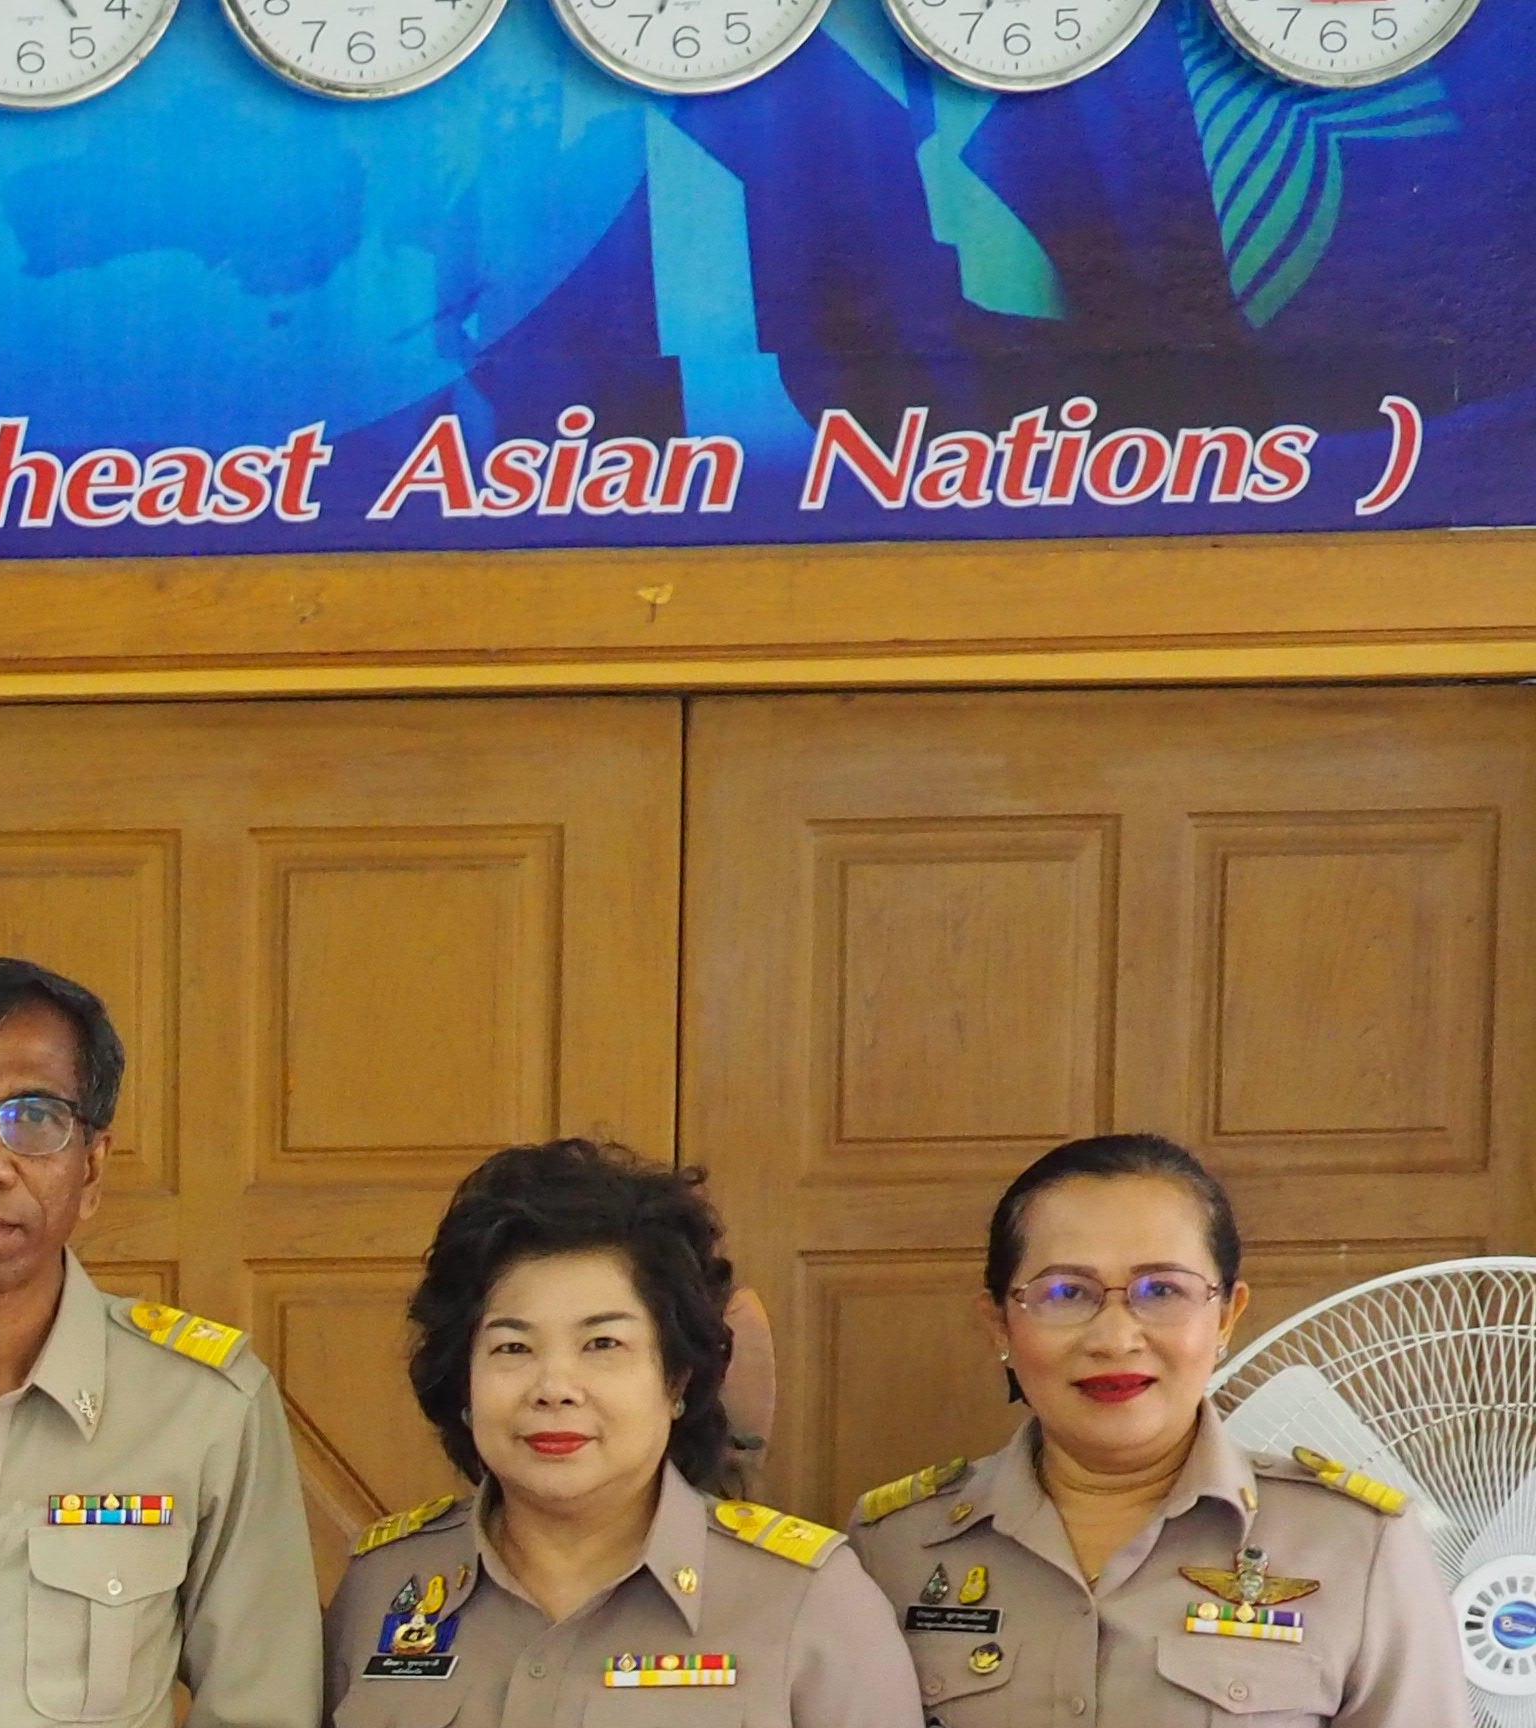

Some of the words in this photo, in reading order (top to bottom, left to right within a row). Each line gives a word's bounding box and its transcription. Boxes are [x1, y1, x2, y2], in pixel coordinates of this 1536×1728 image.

[301, 20, 327, 54] 7
[399, 16, 427, 50] 5
[627, 13, 654, 47] 7
[724, 11, 752, 46] 5
[958, 11, 984, 45] 7
[1002, 22, 1032, 56] 6
[1054, 7, 1081, 42] 5
[1276, 7, 1302, 41] 7
[1319, 19, 1348, 54] 6
[1371, 7, 1398, 41] 5
[16, 40, 46, 74] 6
[69, 26, 96, 60] 5
[346, 30, 376, 65] 6
[672, 25, 701, 59] 6
[378, 410, 739, 515] Asian
[805, 400, 1312, 507] Nations
